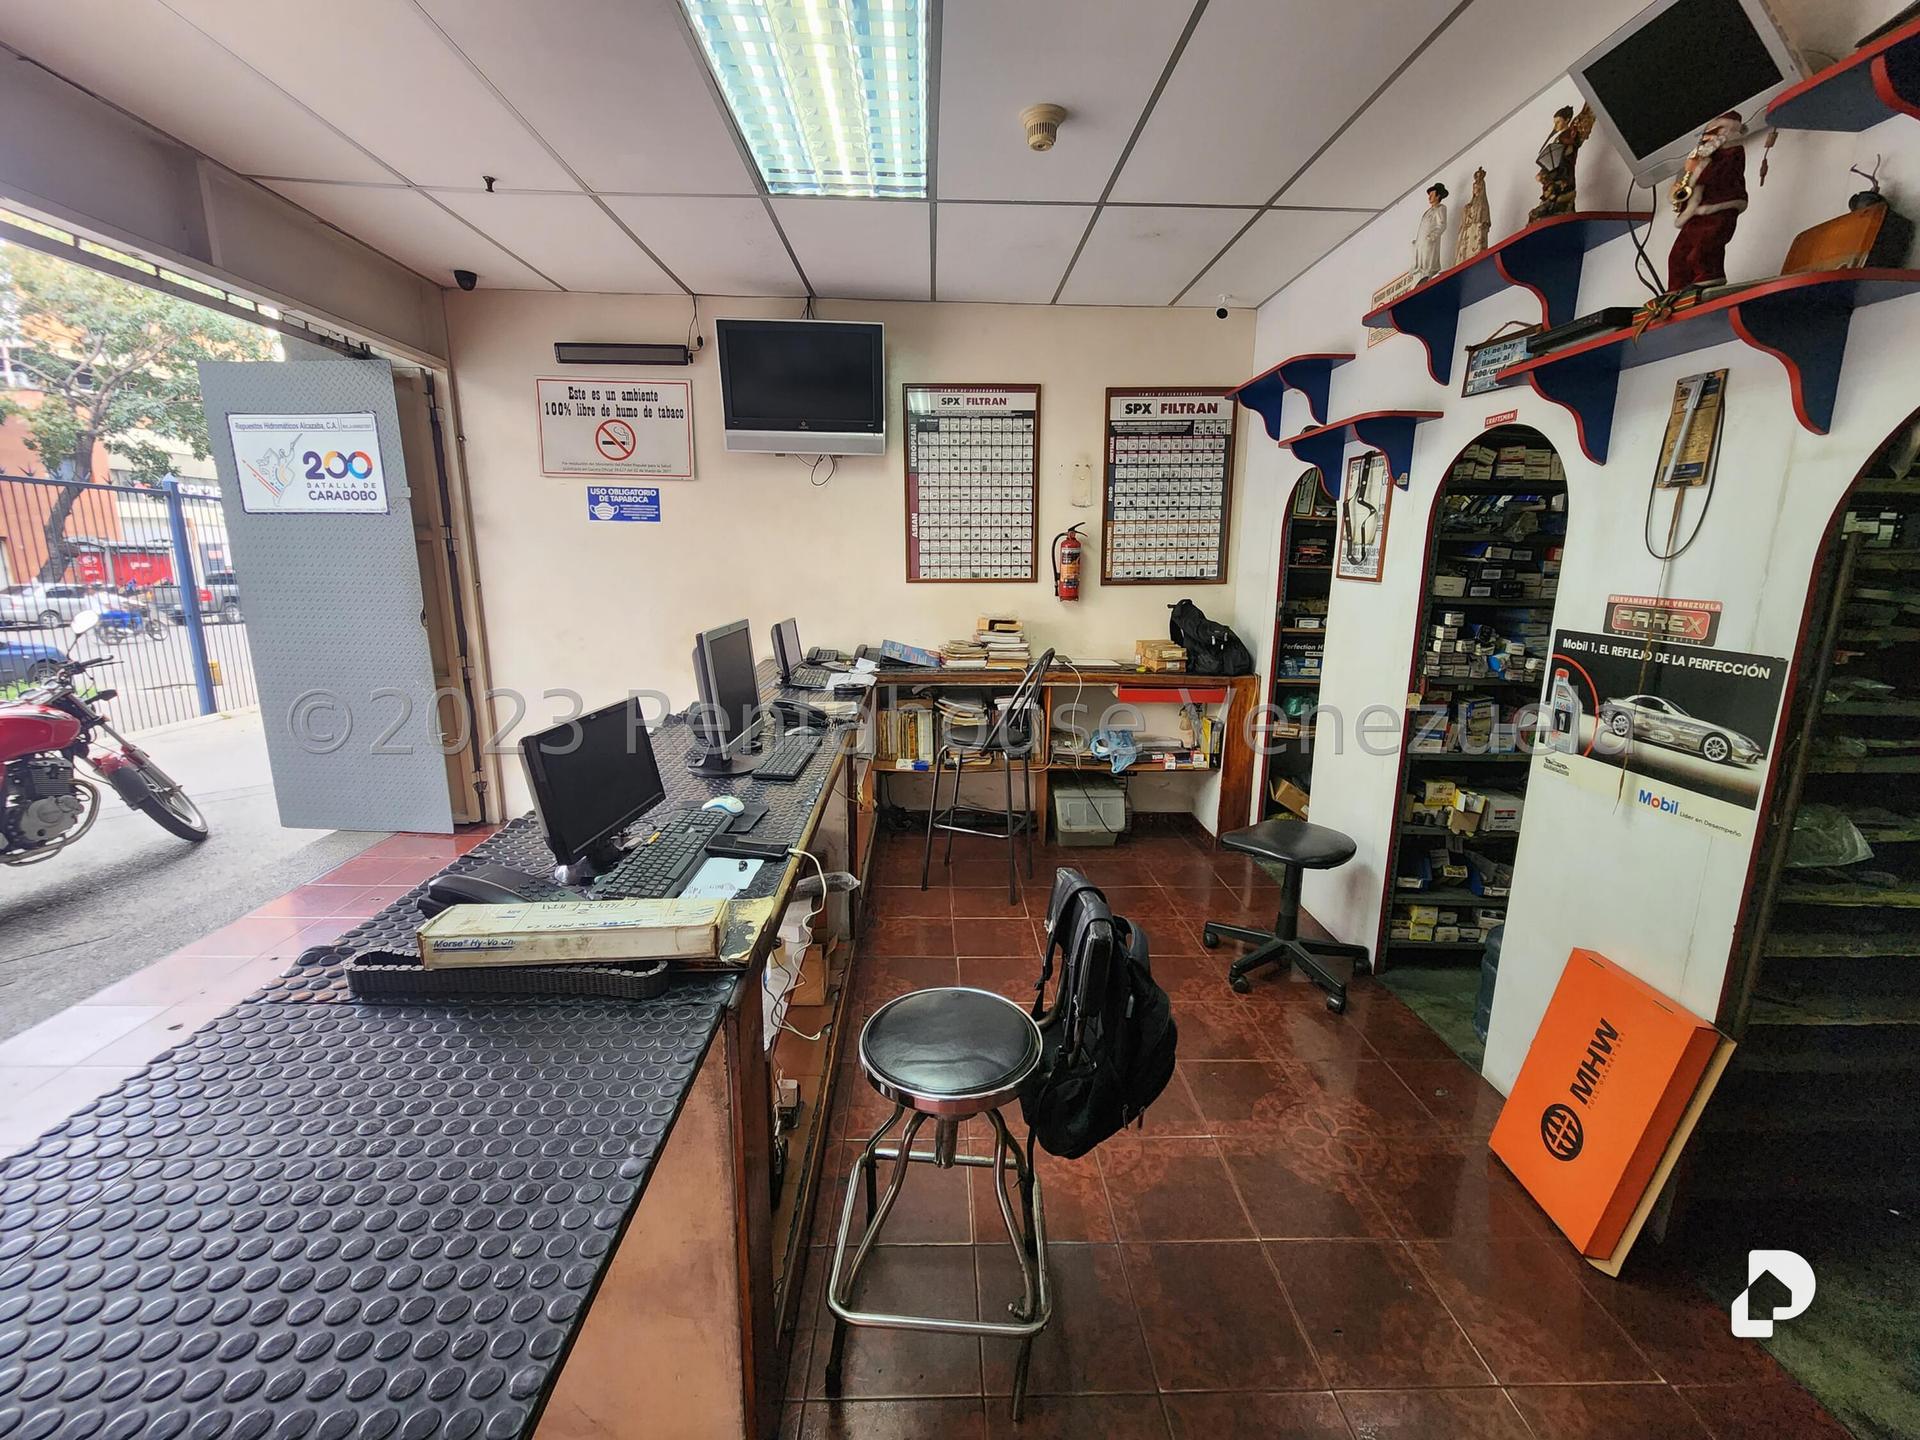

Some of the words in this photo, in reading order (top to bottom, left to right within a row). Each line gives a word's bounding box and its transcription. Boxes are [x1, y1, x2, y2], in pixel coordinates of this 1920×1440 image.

[568, 386, 586, 400] Este
[592, 390, 600, 400] es
[606, 390, 616, 401] un
[622, 388, 658, 402] ambiente
[941, 398, 960, 406] SPX
[966, 398, 1006, 406] FILTRAN
[545, 402, 572, 417] 100%
[576, 404, 596, 417] libre
[601, 404, 610, 417] de
[616, 404, 638, 418] humo
[644, 406, 653, 419] de
[658, 406, 684, 419] tabaco
[1125, 403, 1152, 414] SPX
[1160, 403, 1218, 414] FILTRAN
[910, 423, 918, 468] EUROPEAN
[302, 450, 373, 480] 200
[308, 490, 377, 500] CARABOBO
[590, 488, 606, 496] USO
[608, 488, 656, 496] OBLIGATORIO
[1672, 600, 1721, 610] VENEZUELA
[1562, 638, 1588, 651] Mobil
[1591, 644, 1598, 654] 1,
[1600, 644, 1610, 656] EL
[1612, 646, 1652, 662] REFLEJO
[1655, 652, 1669, 665] DE
[1672, 654, 1686, 667] LA
[1688, 657, 1770, 680] PERFECCIÓN
[1638, 790, 1679, 815] Mobil
[1704, 820, 1742, 838] Desempeño
[470, 938, 499, 949] Hy-Vo
[1569, 1017, 1619, 1105] MHW
